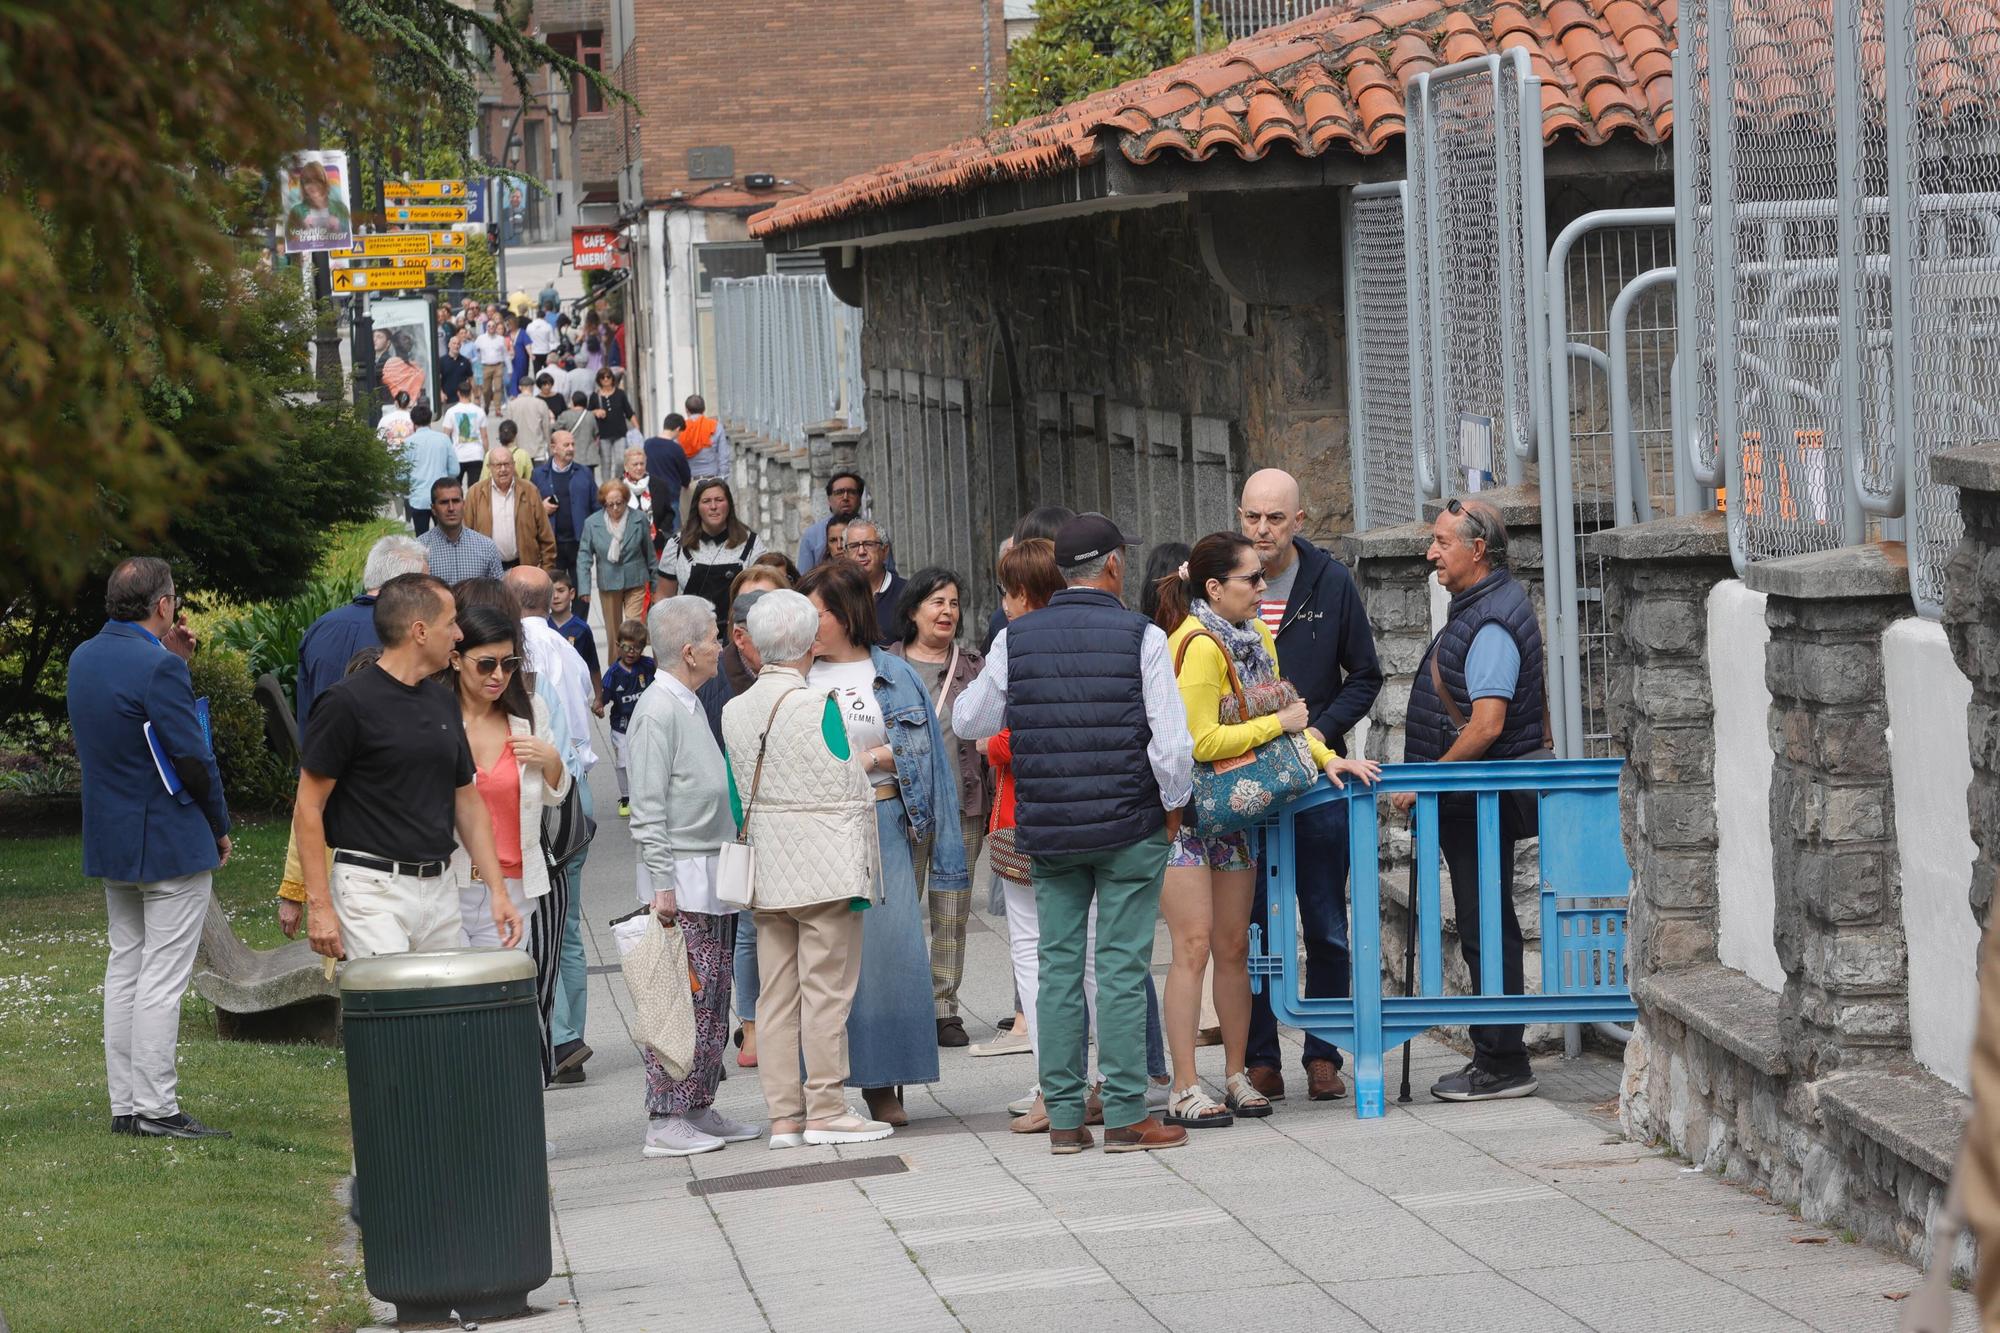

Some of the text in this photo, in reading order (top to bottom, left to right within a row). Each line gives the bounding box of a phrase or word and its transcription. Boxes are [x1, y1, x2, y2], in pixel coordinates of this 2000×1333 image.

[431, 210, 451, 218] Oviedo
[582, 235, 606, 248] CAFE
[849, 713, 876, 725] FEMME
